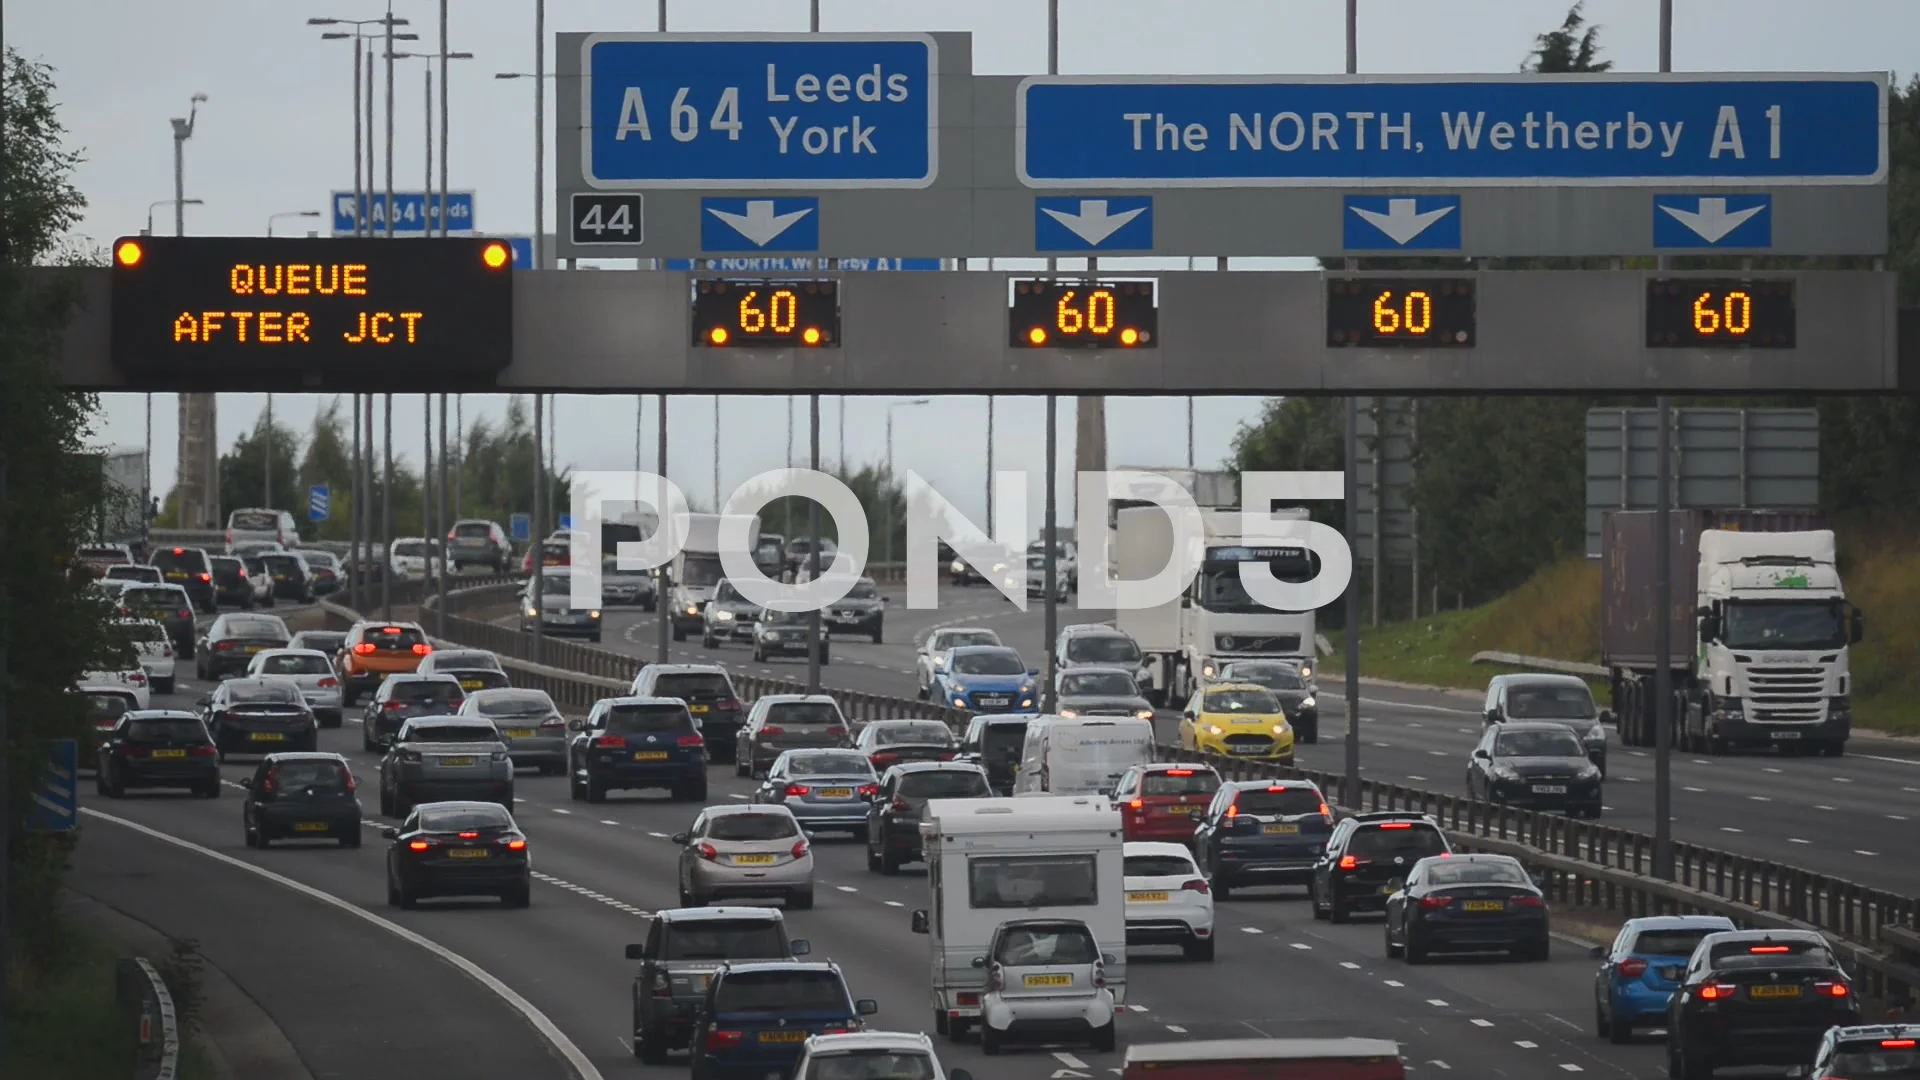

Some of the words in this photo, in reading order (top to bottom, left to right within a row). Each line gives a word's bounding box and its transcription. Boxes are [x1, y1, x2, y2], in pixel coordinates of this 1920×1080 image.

[767, 63, 908, 103] Leeds
[769, 115, 878, 155] York
[1123, 112, 1208, 152] The
[1229, 111, 1424, 155] NORTH,
[1440, 111, 1684, 158] Wetherby
[579, 204, 634, 235] 44
[231, 264, 367, 296] QUEUE
[174, 311, 310, 343] AFTER
[343, 311, 423, 343] JCT
[739, 290, 796, 333] 60
[1057, 290, 1114, 334] 60
[1374, 291, 1431, 334] 60
[1693, 291, 1751, 334] 60
